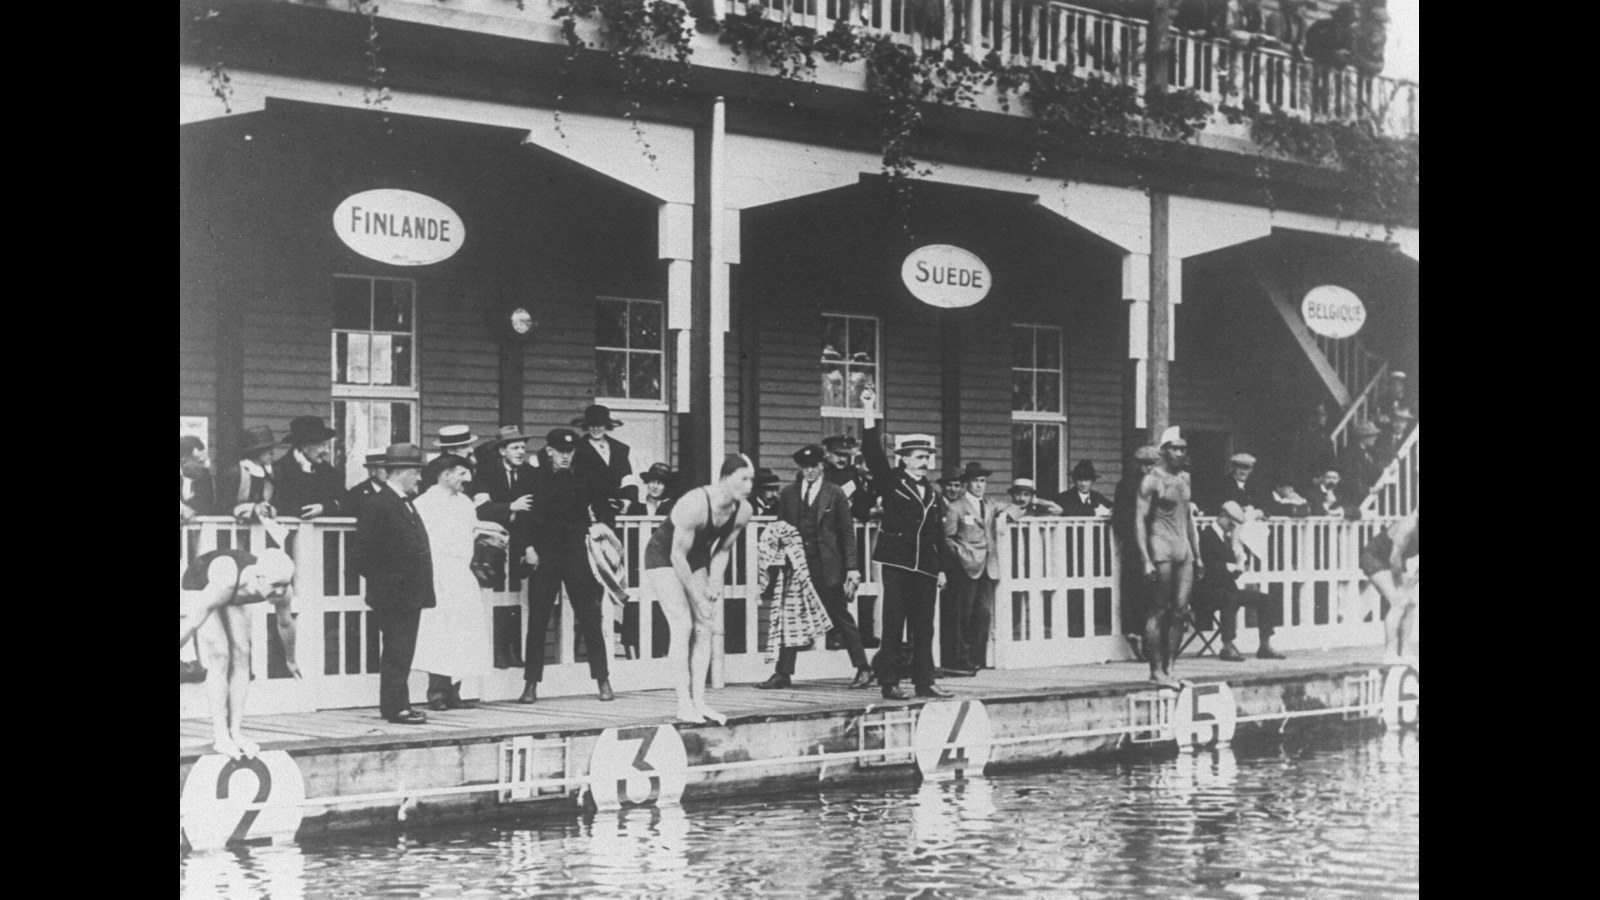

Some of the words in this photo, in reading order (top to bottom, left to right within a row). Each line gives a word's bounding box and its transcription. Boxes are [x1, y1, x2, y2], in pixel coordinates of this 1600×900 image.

[351, 206, 451, 242] FINLANDE
[915, 260, 983, 289] SUEDE
[1308, 301, 1362, 322] BELGIQUE
[1190, 685, 1219, 750] 5
[1398, 666, 1419, 732] 6
[617, 727, 660, 809] 3
[936, 700, 970, 776] 4
[215, 756, 272, 849] 2
